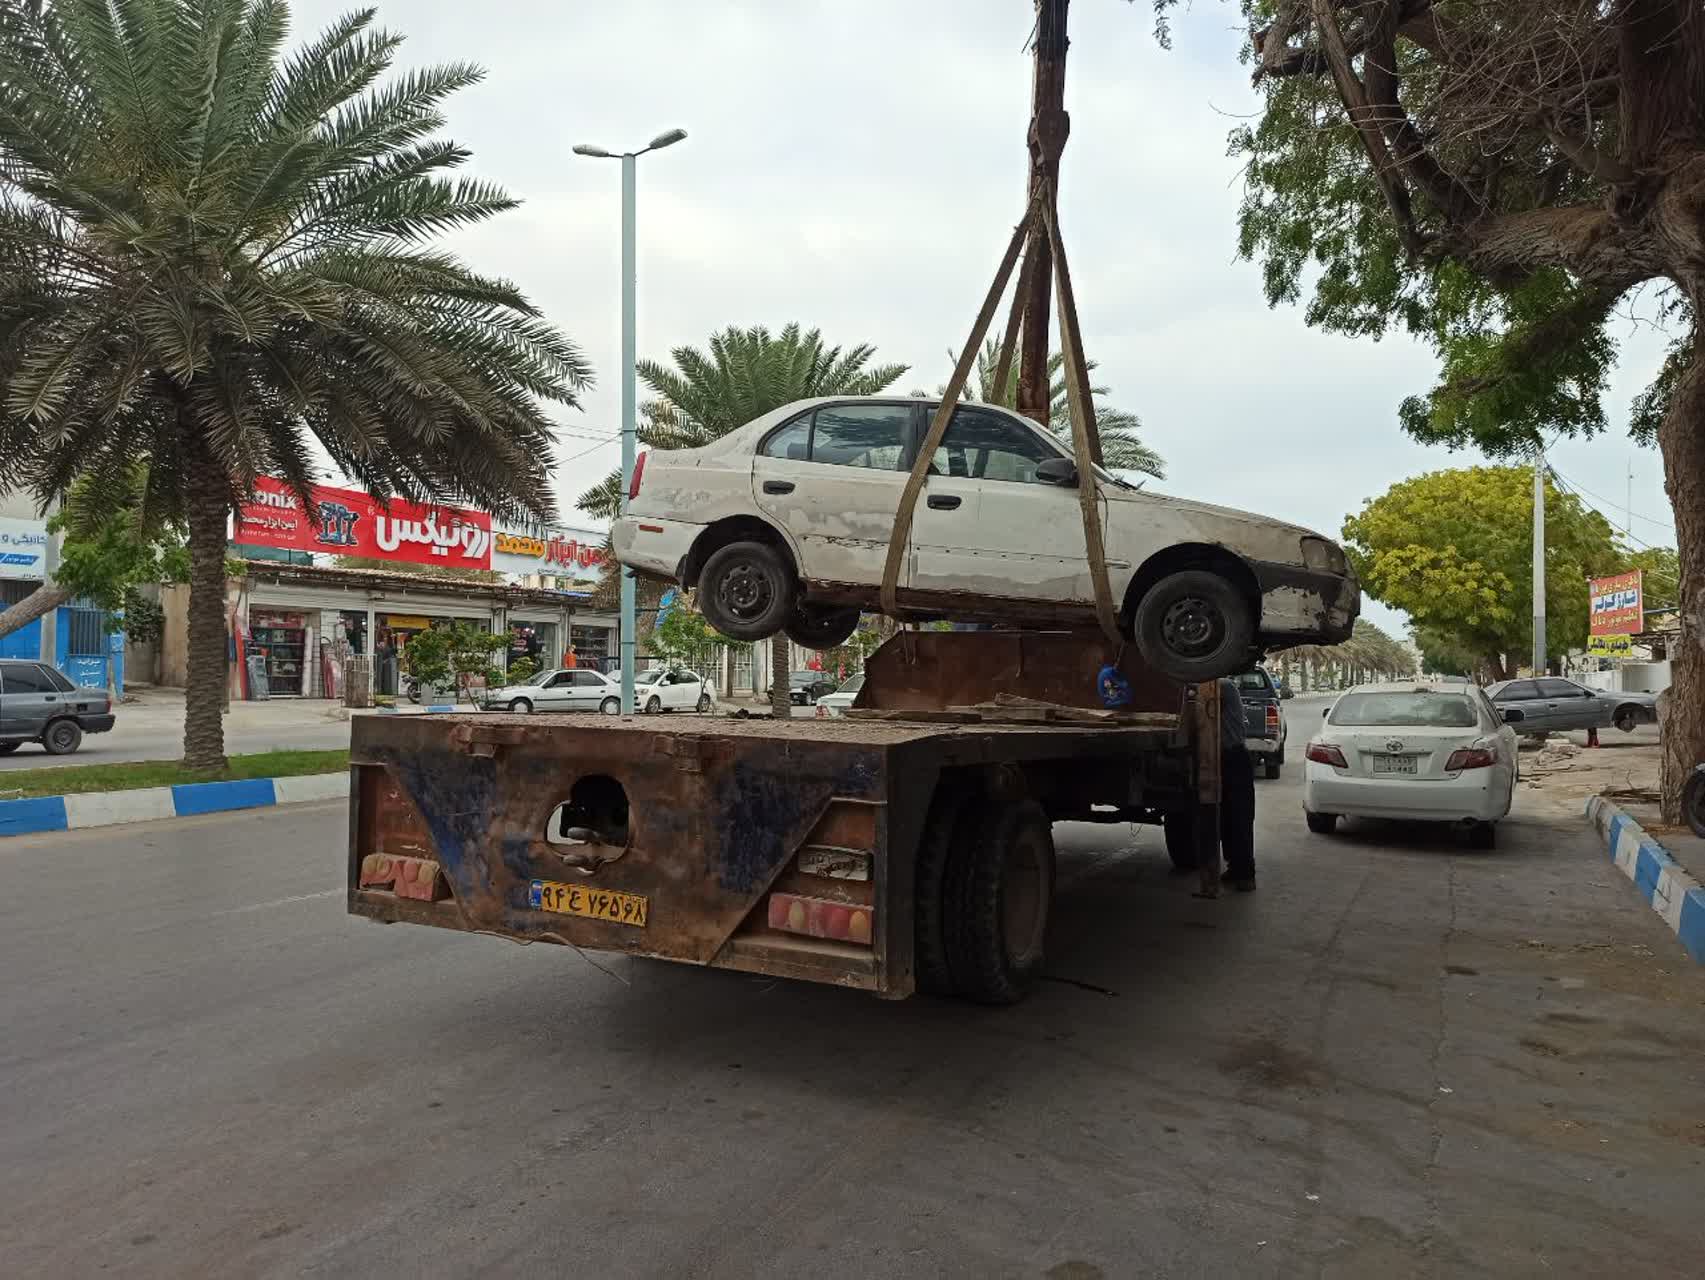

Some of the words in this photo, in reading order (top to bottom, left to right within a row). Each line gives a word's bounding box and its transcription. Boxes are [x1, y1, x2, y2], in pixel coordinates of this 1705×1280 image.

[253, 490, 297, 509] onix
[377, 511, 489, 558] رونیکس
[496, 533, 545, 558] محمد
[545, 535, 578, 568] ابزار
[1595, 594, 1616, 613] کولر
[1617, 590, 1636, 609] شارژ
